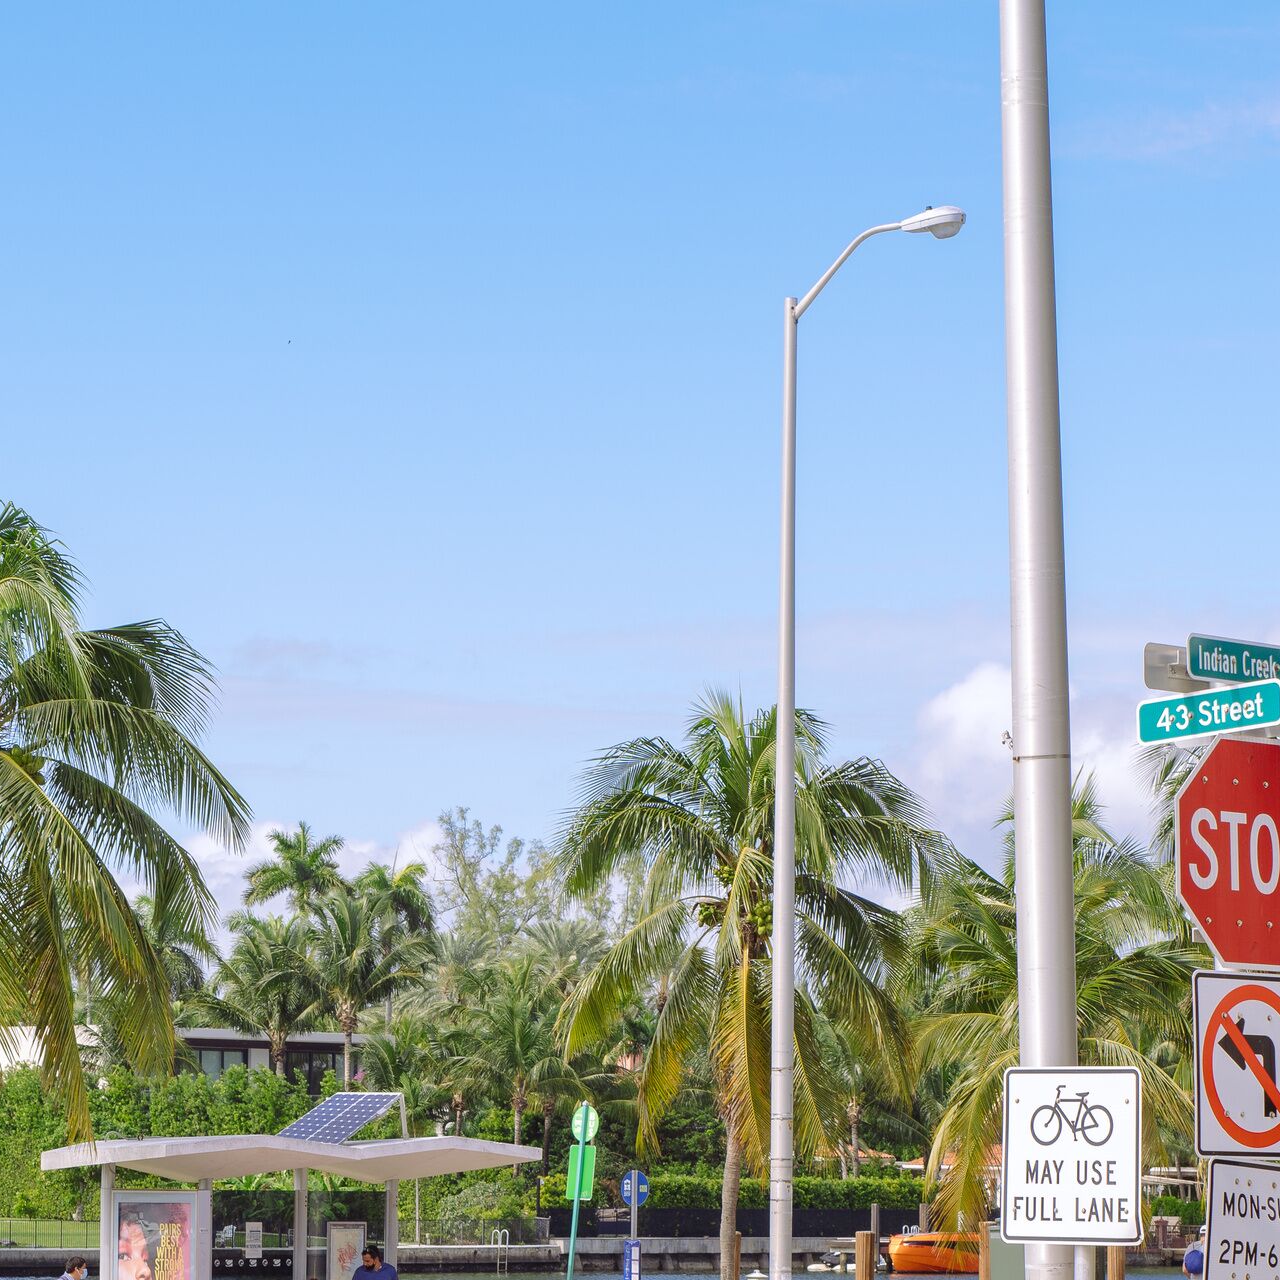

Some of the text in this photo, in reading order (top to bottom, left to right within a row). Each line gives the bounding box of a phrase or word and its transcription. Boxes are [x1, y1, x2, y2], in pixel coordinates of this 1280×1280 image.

[1198, 645, 1237, 675] Indian
[1242, 650, 1278, 679] Creek
[1156, 692, 1264, 732] 43 Street
[1025, 1159, 1117, 1185] MAY USE
[1013, 1196, 1128, 1223] FULL LANE
[159, 1223, 182, 1236] PAIRS
[161, 1235, 180, 1247] BEST
[156, 1247, 183, 1259] WITH A
[154, 1259, 184, 1271] STRONG
